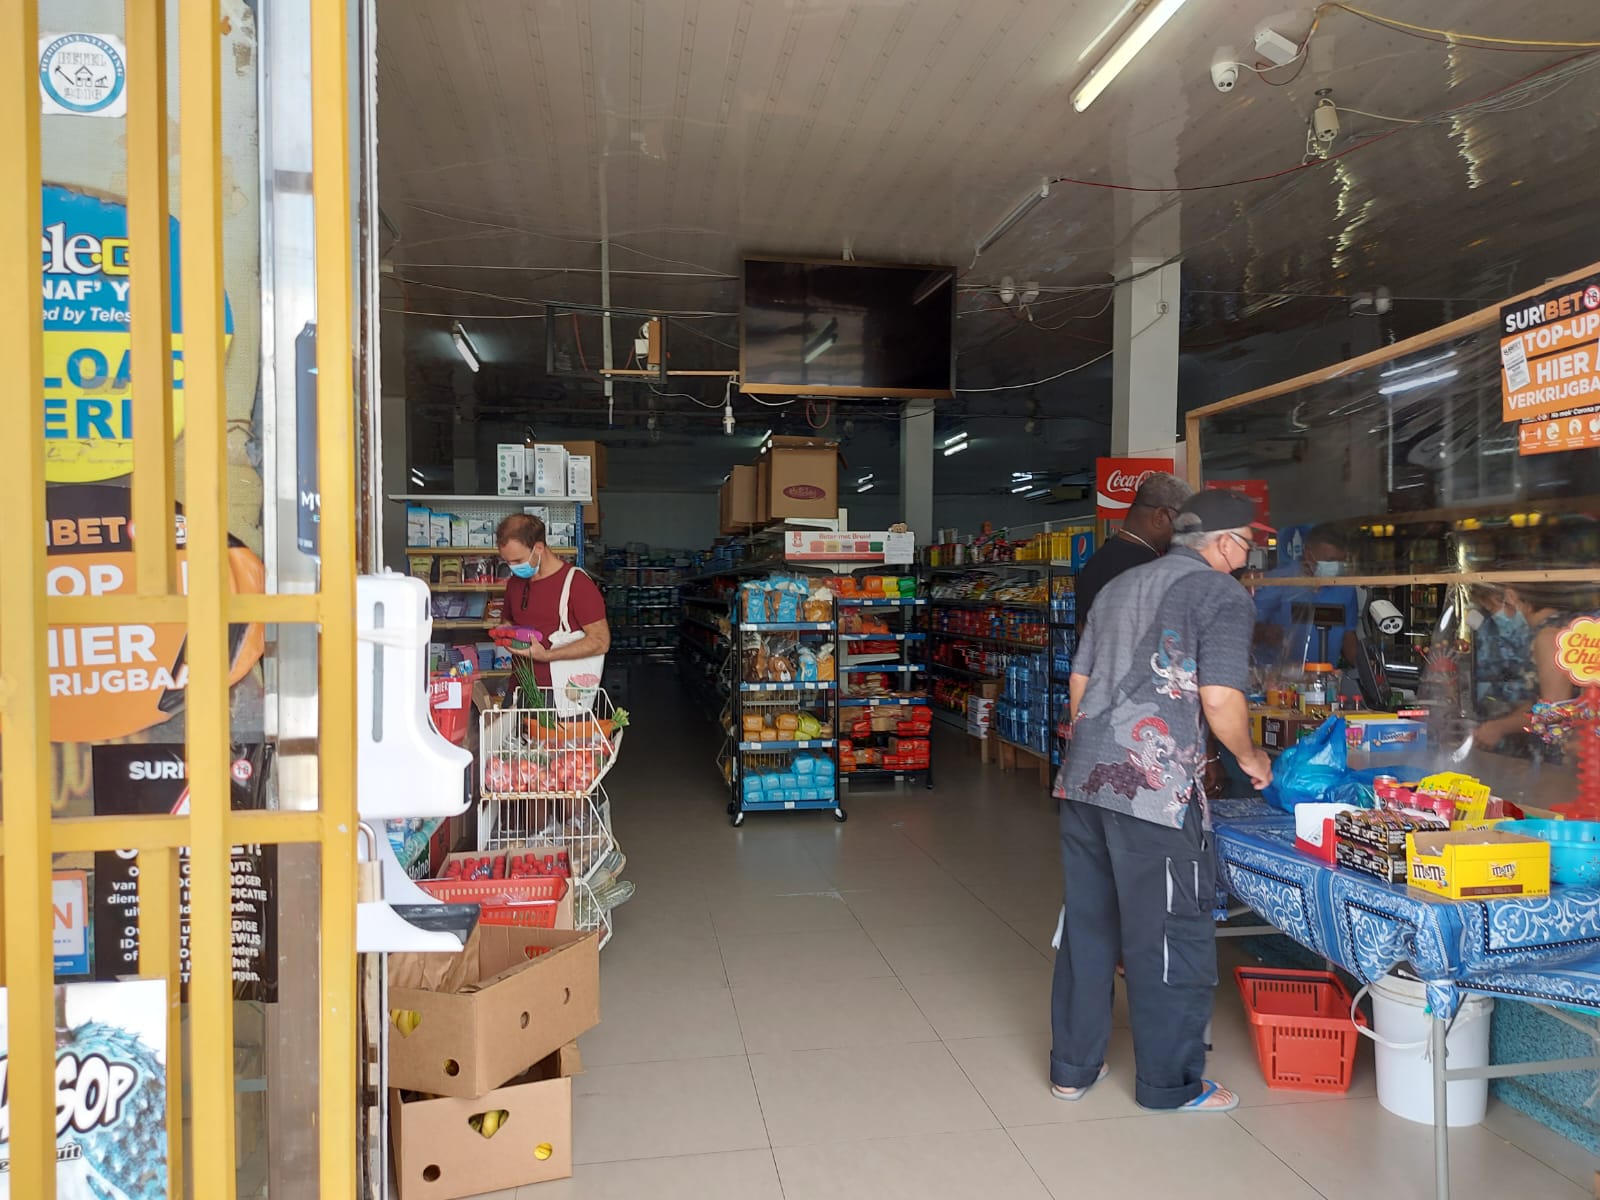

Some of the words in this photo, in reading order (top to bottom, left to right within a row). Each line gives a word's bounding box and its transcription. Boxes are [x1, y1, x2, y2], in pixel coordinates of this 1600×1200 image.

[110, 281, 130, 301] Y
[62, 306, 87, 325] by
[89, 306, 131, 323] Teles
[1505, 291, 1583, 333] SURIBET
[1524, 314, 1600, 352] TOP-UP
[1536, 351, 1590, 385] HIER
[1507, 375, 1600, 410] VERKRIJGBA
[1107, 470, 1156, 493] Coca-C
[1567, 633, 1600, 648] Chu
[1564, 649, 1600, 664] Chu
[128, 761, 186, 780] SURI
[231, 874, 262, 887] OGER
[231, 887, 268, 902] FICATIE
[231, 920, 259, 933] DIGE
[55, 1052, 138, 1139] SOP
